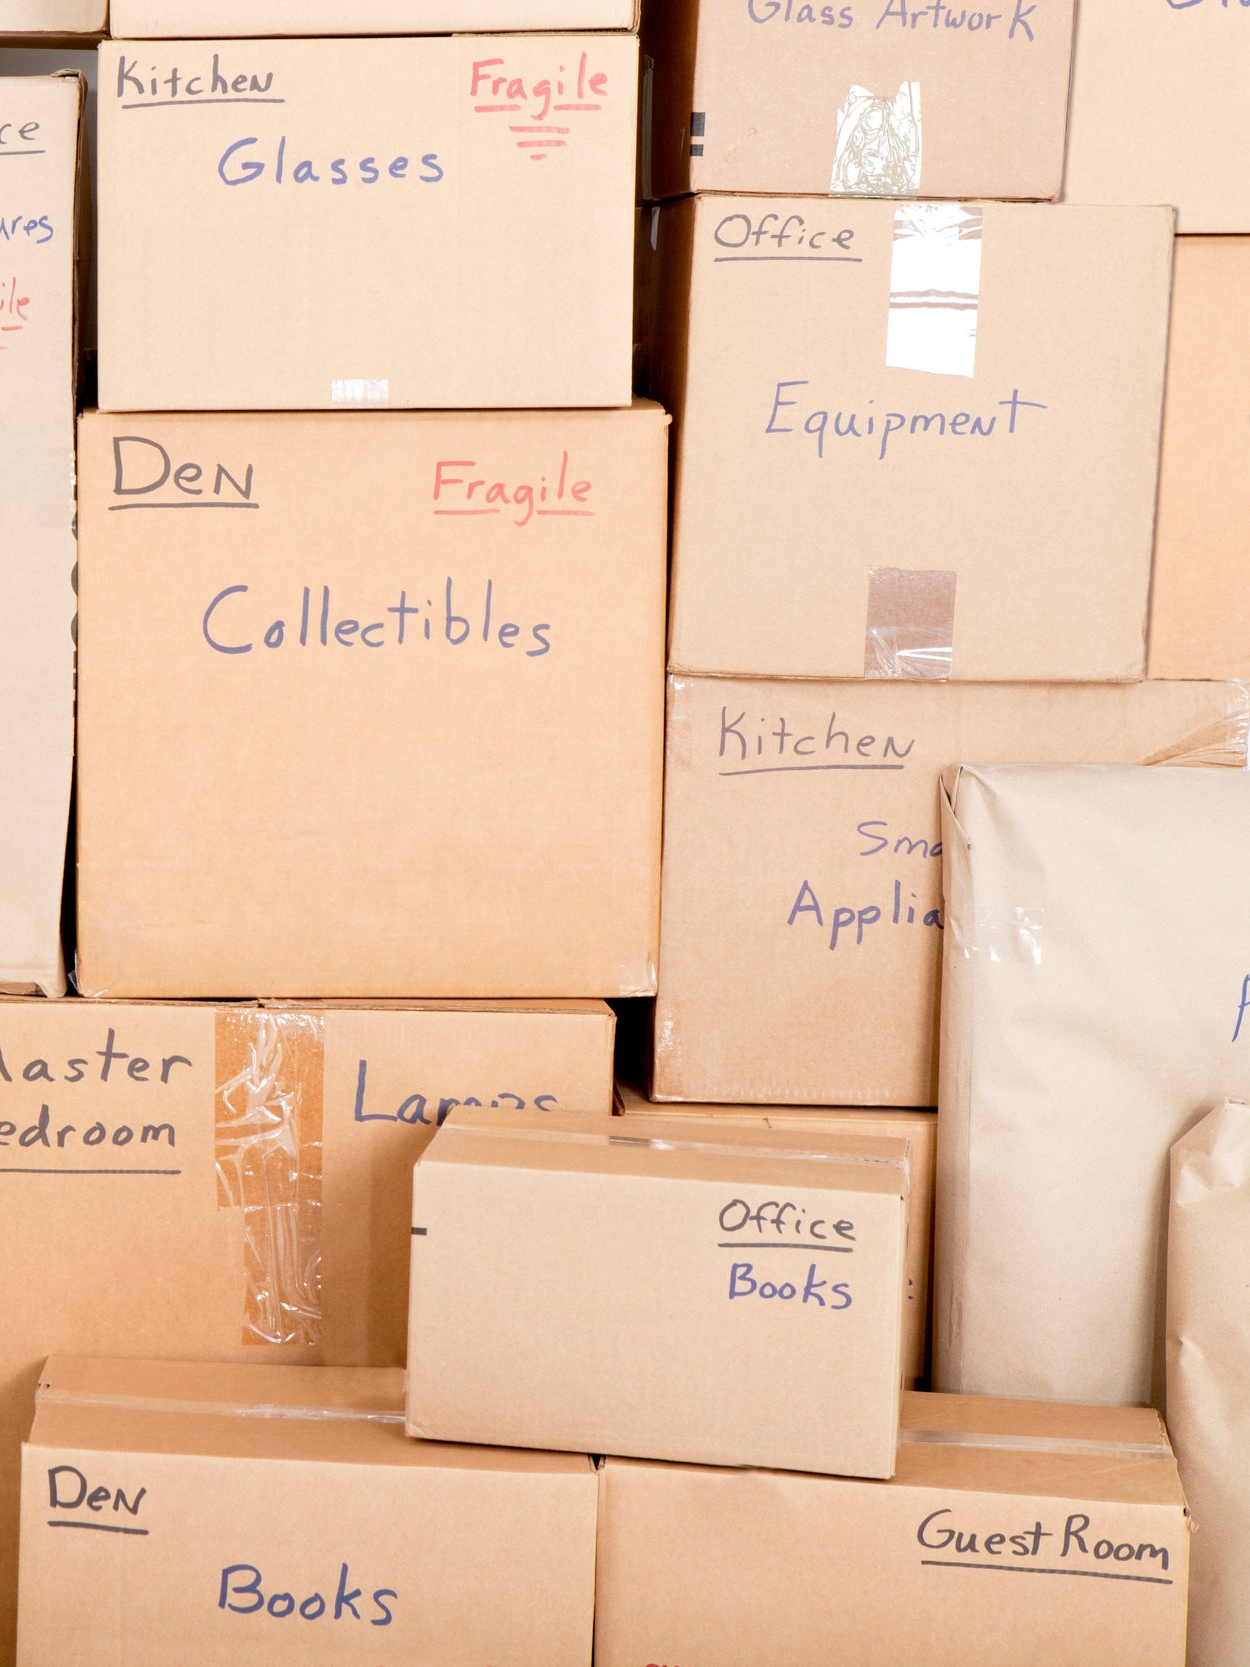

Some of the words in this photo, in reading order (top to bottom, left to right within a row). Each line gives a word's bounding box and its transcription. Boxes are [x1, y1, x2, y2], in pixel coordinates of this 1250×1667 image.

[747, 0, 854, 29] Glass
[117, 54, 274, 98] Kitchen
[470, 52, 609, 120] Fragile
[217, 136, 444, 186] Glasses
[713, 213, 855, 250] Office
[765, 380, 1048, 461] Equipment
[432, 451, 593, 526] Fragile
[202, 576, 551, 658] Collectibles
[718, 706, 915, 760] Kitchen
[718, 1199, 856, 1242] Office
[729, 1263, 853, 1310] Books
[917, 1508, 1053, 1557] Guest
[1060, 1513, 1170, 1570] Room
[217, 1562, 399, 1627] Books
